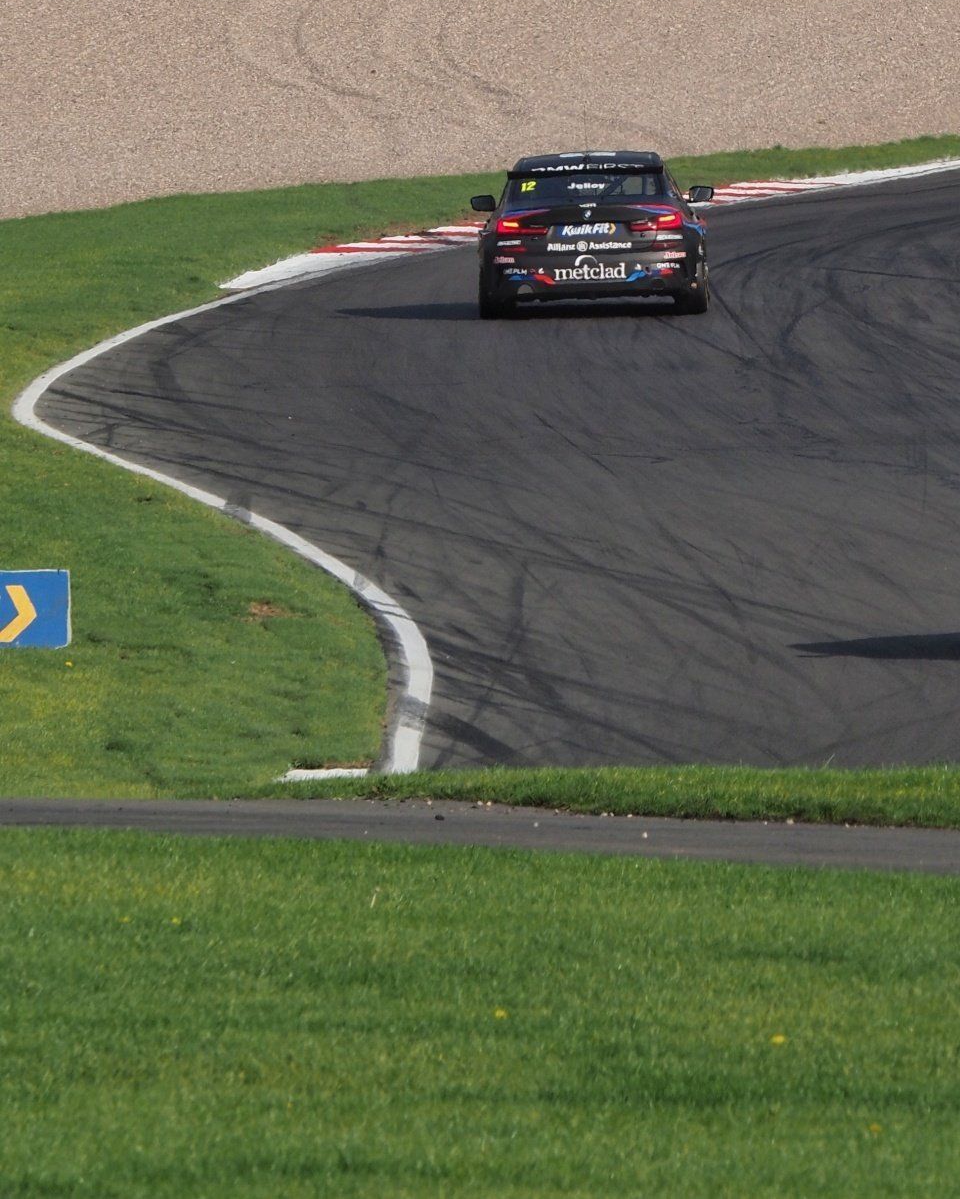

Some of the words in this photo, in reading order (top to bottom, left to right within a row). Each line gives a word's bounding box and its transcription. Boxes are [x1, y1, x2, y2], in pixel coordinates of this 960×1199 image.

[521, 181, 536, 192] 12
[547, 243, 576, 252] Allianz
[588, 242, 632, 251] Assistance
[554, 263, 627, 281] metclad
